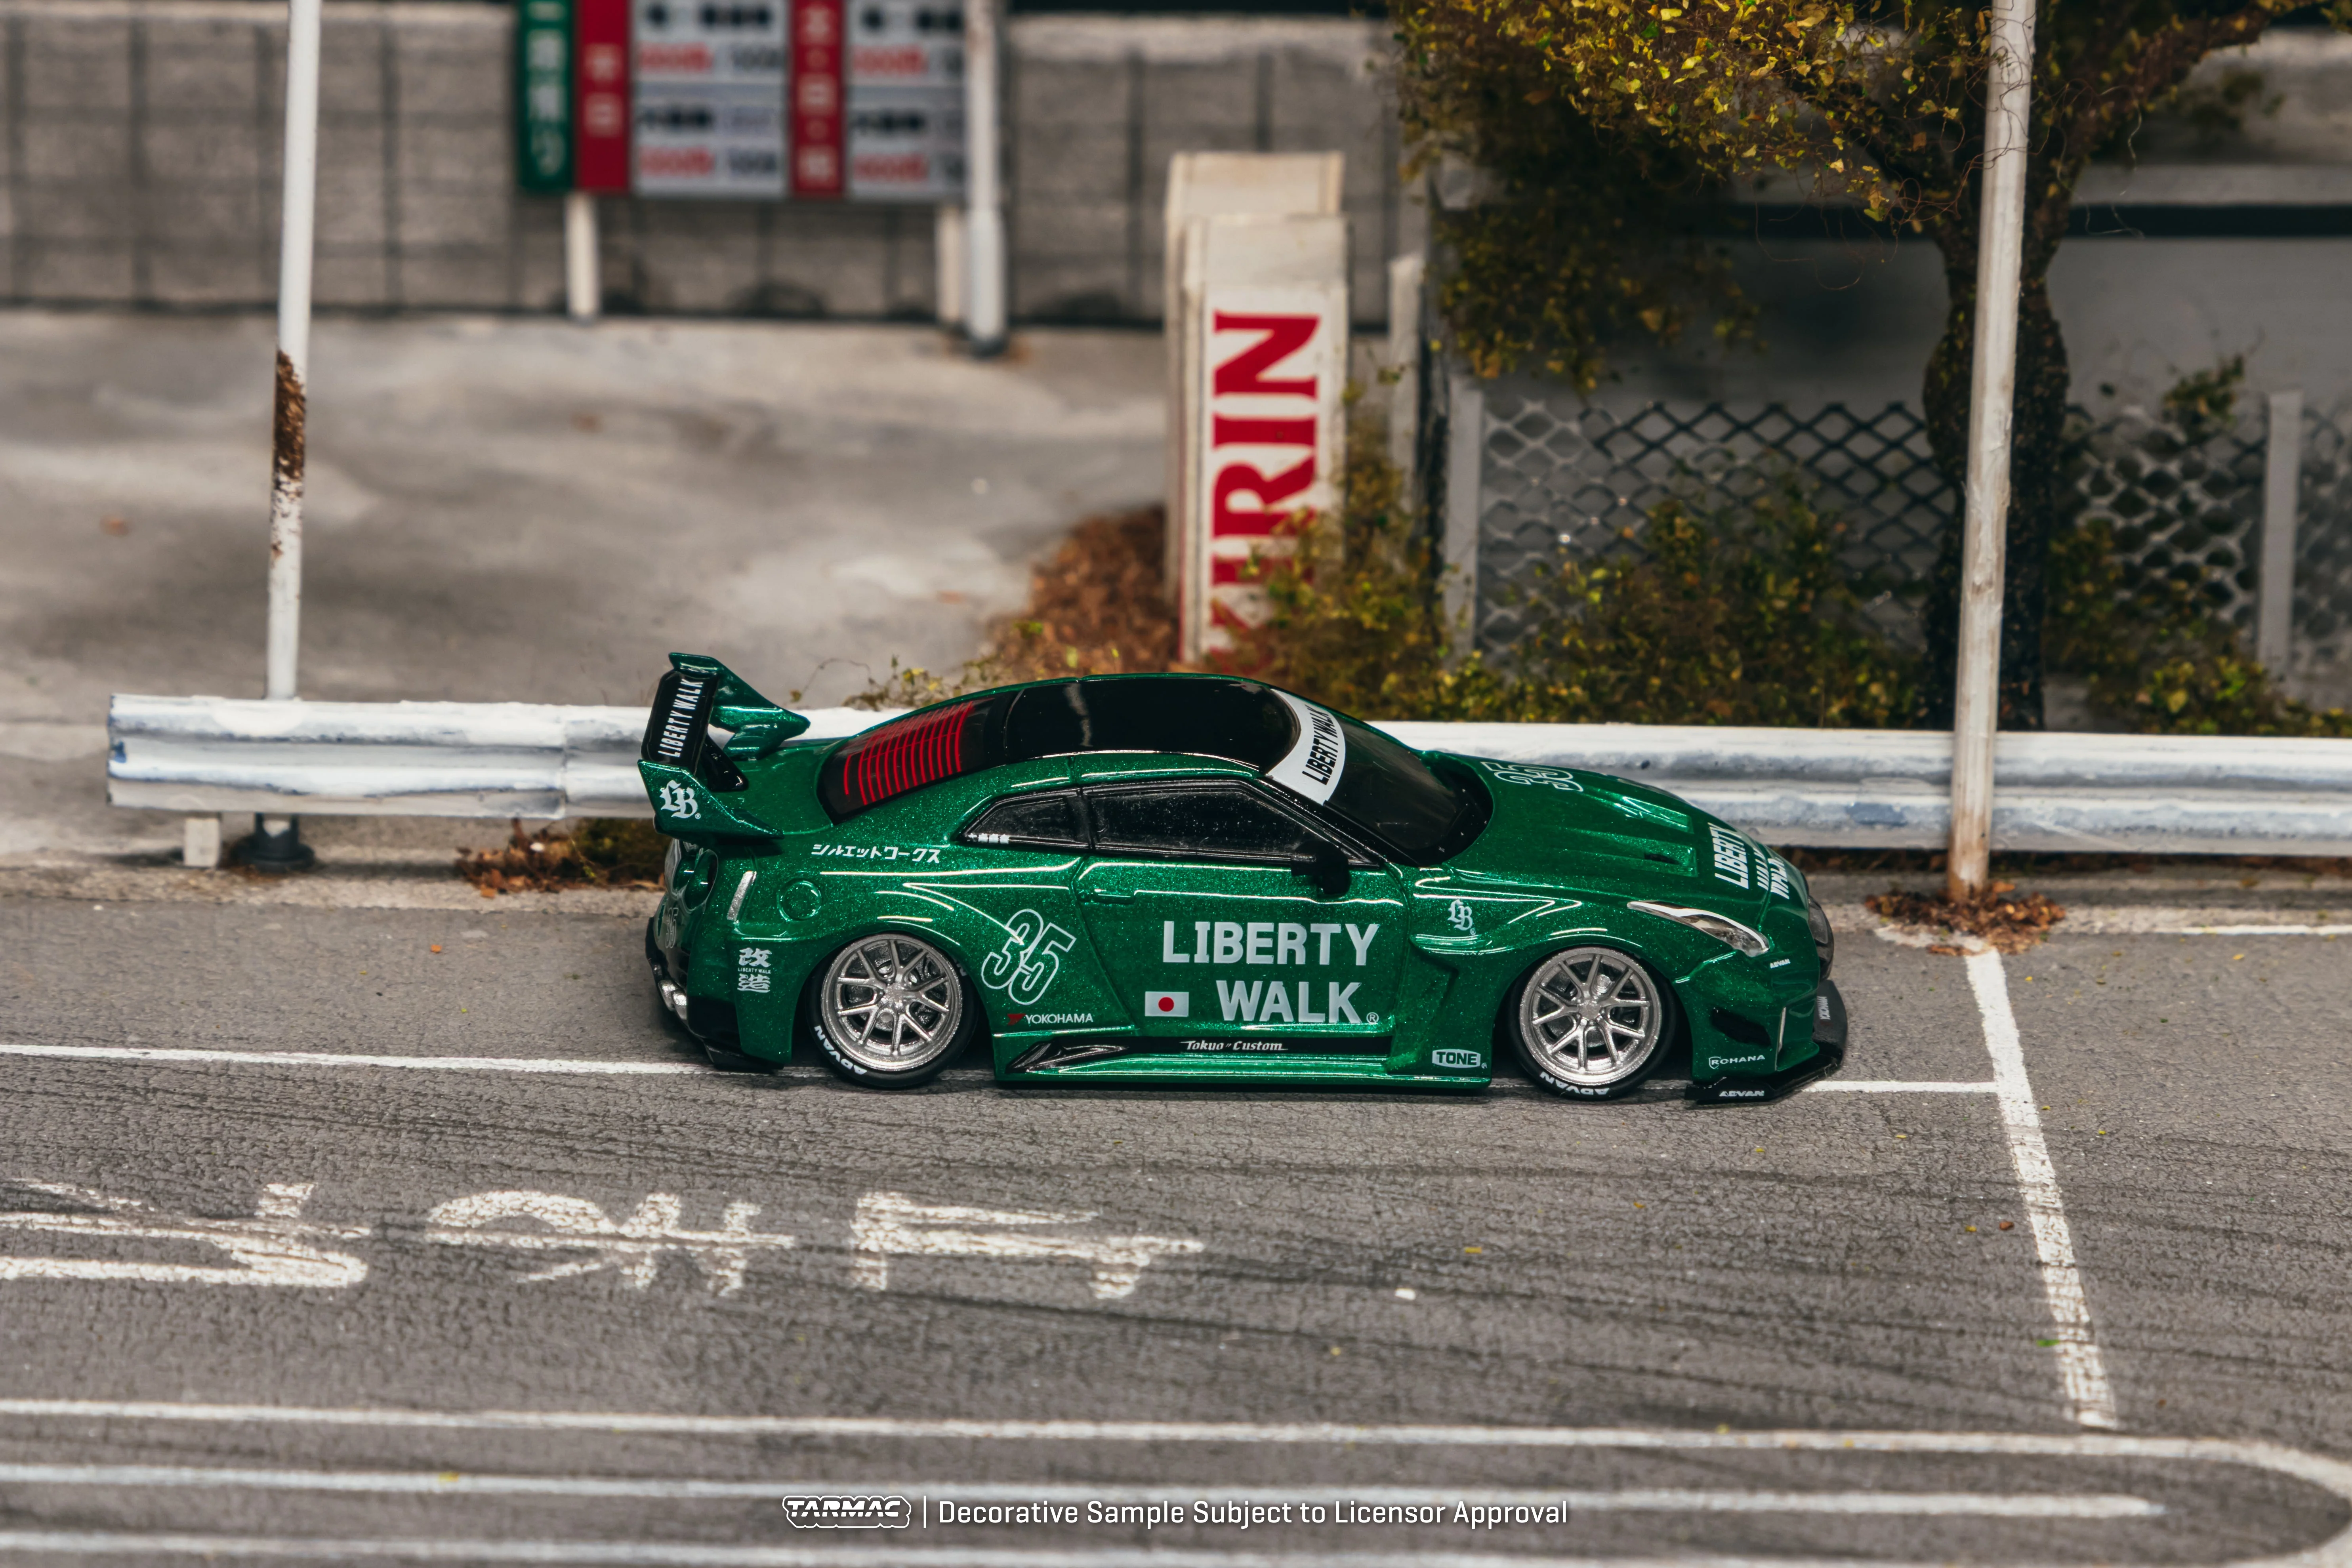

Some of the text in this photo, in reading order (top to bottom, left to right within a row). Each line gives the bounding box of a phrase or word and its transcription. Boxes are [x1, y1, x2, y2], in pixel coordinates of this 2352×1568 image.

[658, 678, 704, 757] LIBERTY WALK
[1302, 704, 1339, 786] LIBERTY WALK
[811, 843, 941, 864] シルエットワークス
[1707, 822, 1749, 889] LIBERTY
[1753, 847, 1790, 900] WALK
[981, 908, 1077, 1005] 35
[1162, 920, 1380, 966] LIBERTY
[1025, 1013, 1094, 1024] YOKOHAMA
[1216, 980, 1363, 1024] WALK
[814, 1024, 868, 1075] ADVAN
[1436, 1051, 1477, 1065] TONE
[1711, 1055, 1765, 1066] ROHANA
[1539, 1071, 1610, 1096] ADVAN
